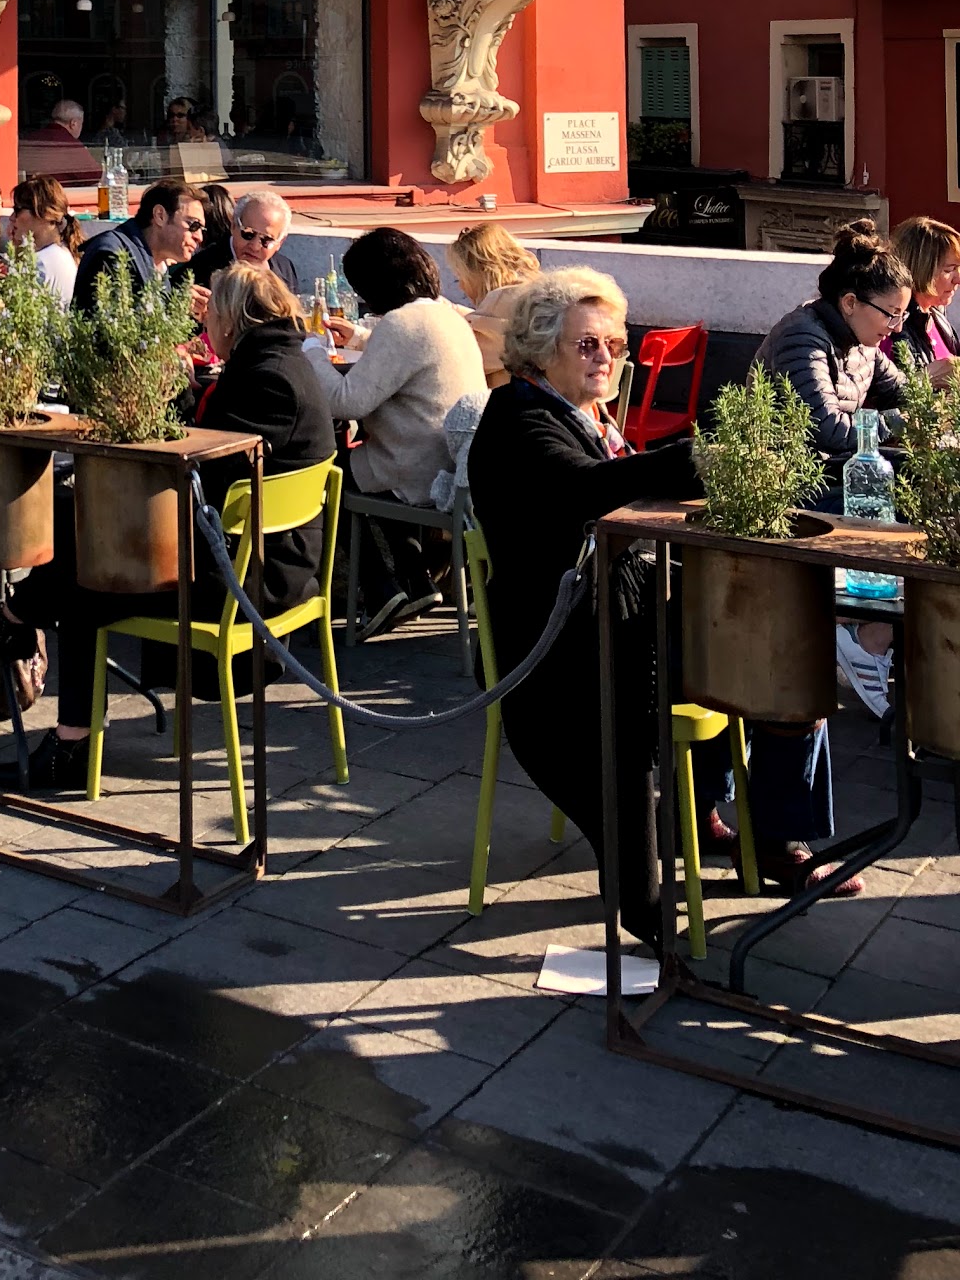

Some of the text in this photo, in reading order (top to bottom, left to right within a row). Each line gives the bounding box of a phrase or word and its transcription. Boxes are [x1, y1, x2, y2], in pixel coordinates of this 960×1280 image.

[567, 119, 597, 128] PLACE
[561, 130, 602, 139] MASSENA
[565, 145, 599, 154] PLASSA
[549, 156, 615, 166] CARLOU AUBERT
